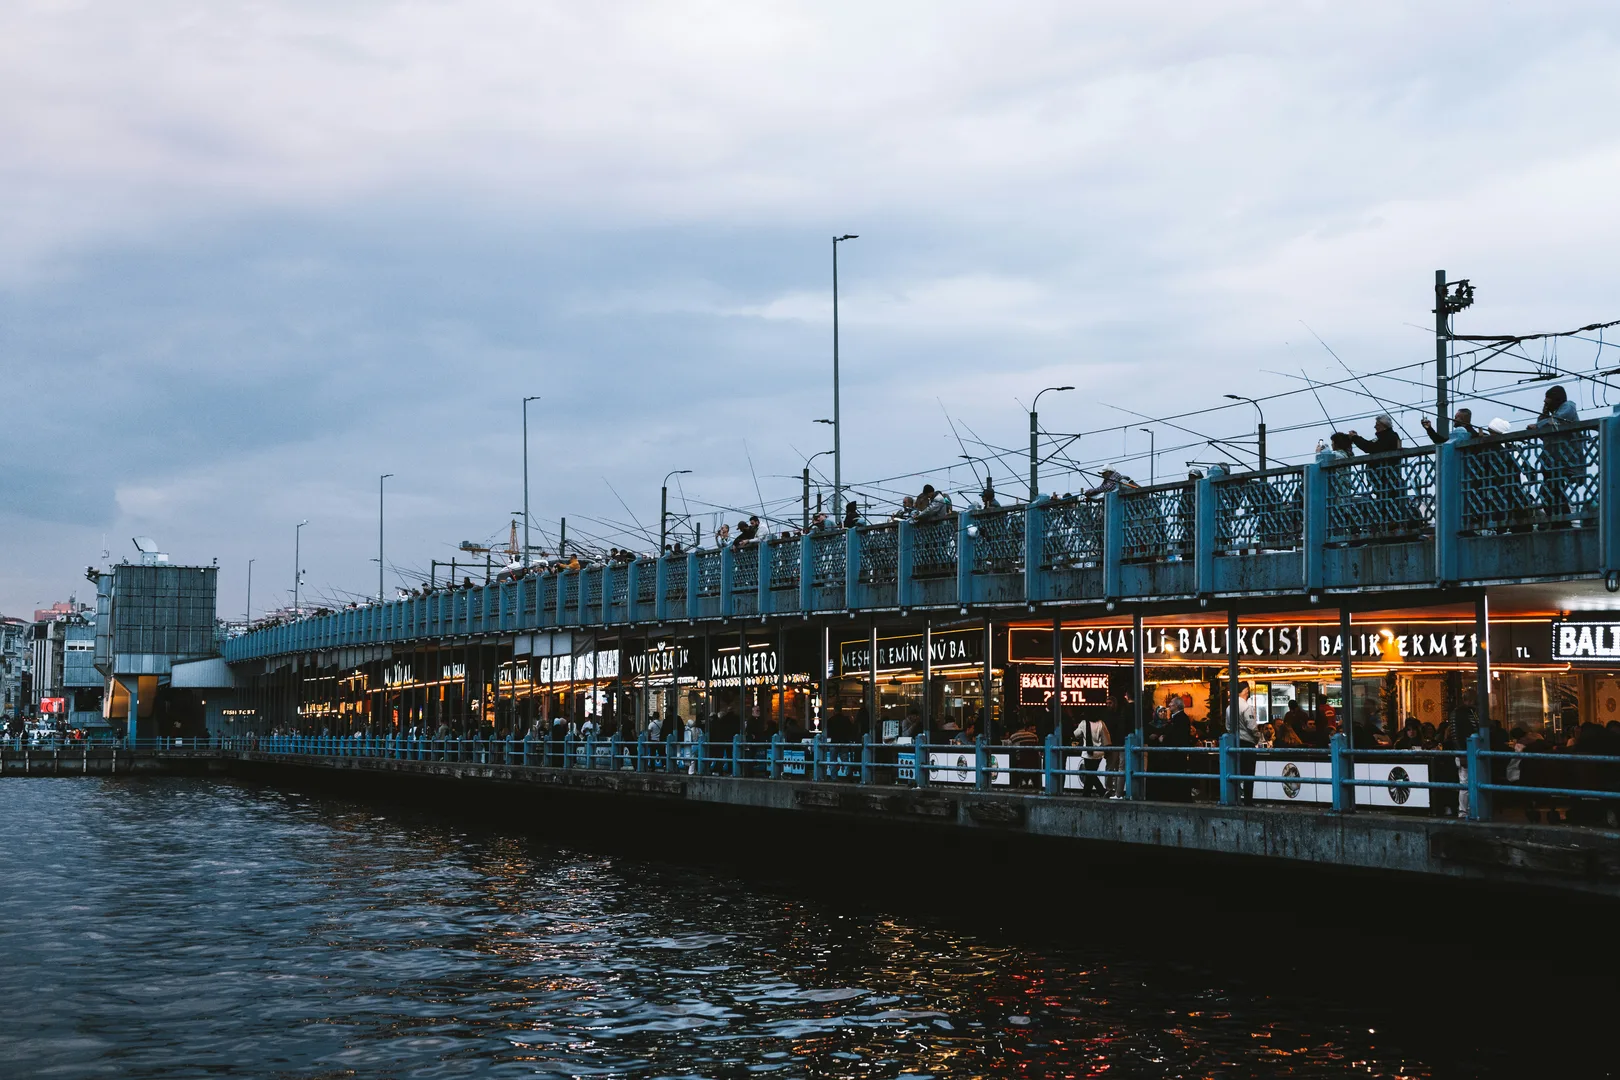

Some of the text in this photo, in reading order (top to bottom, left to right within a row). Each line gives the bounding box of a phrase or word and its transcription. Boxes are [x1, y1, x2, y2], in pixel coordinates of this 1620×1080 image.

[1319, 633, 1382, 657] BALIK
[1516, 646, 1531, 658] TL
[662, 649, 689, 671] BAIK
[711, 651, 777, 678] MARINERO
[843, 649, 889, 671] MEŞHR
[1022, 676, 1108, 689] BALI EKMEK
[1043, 690, 1086, 703] 25 TL
